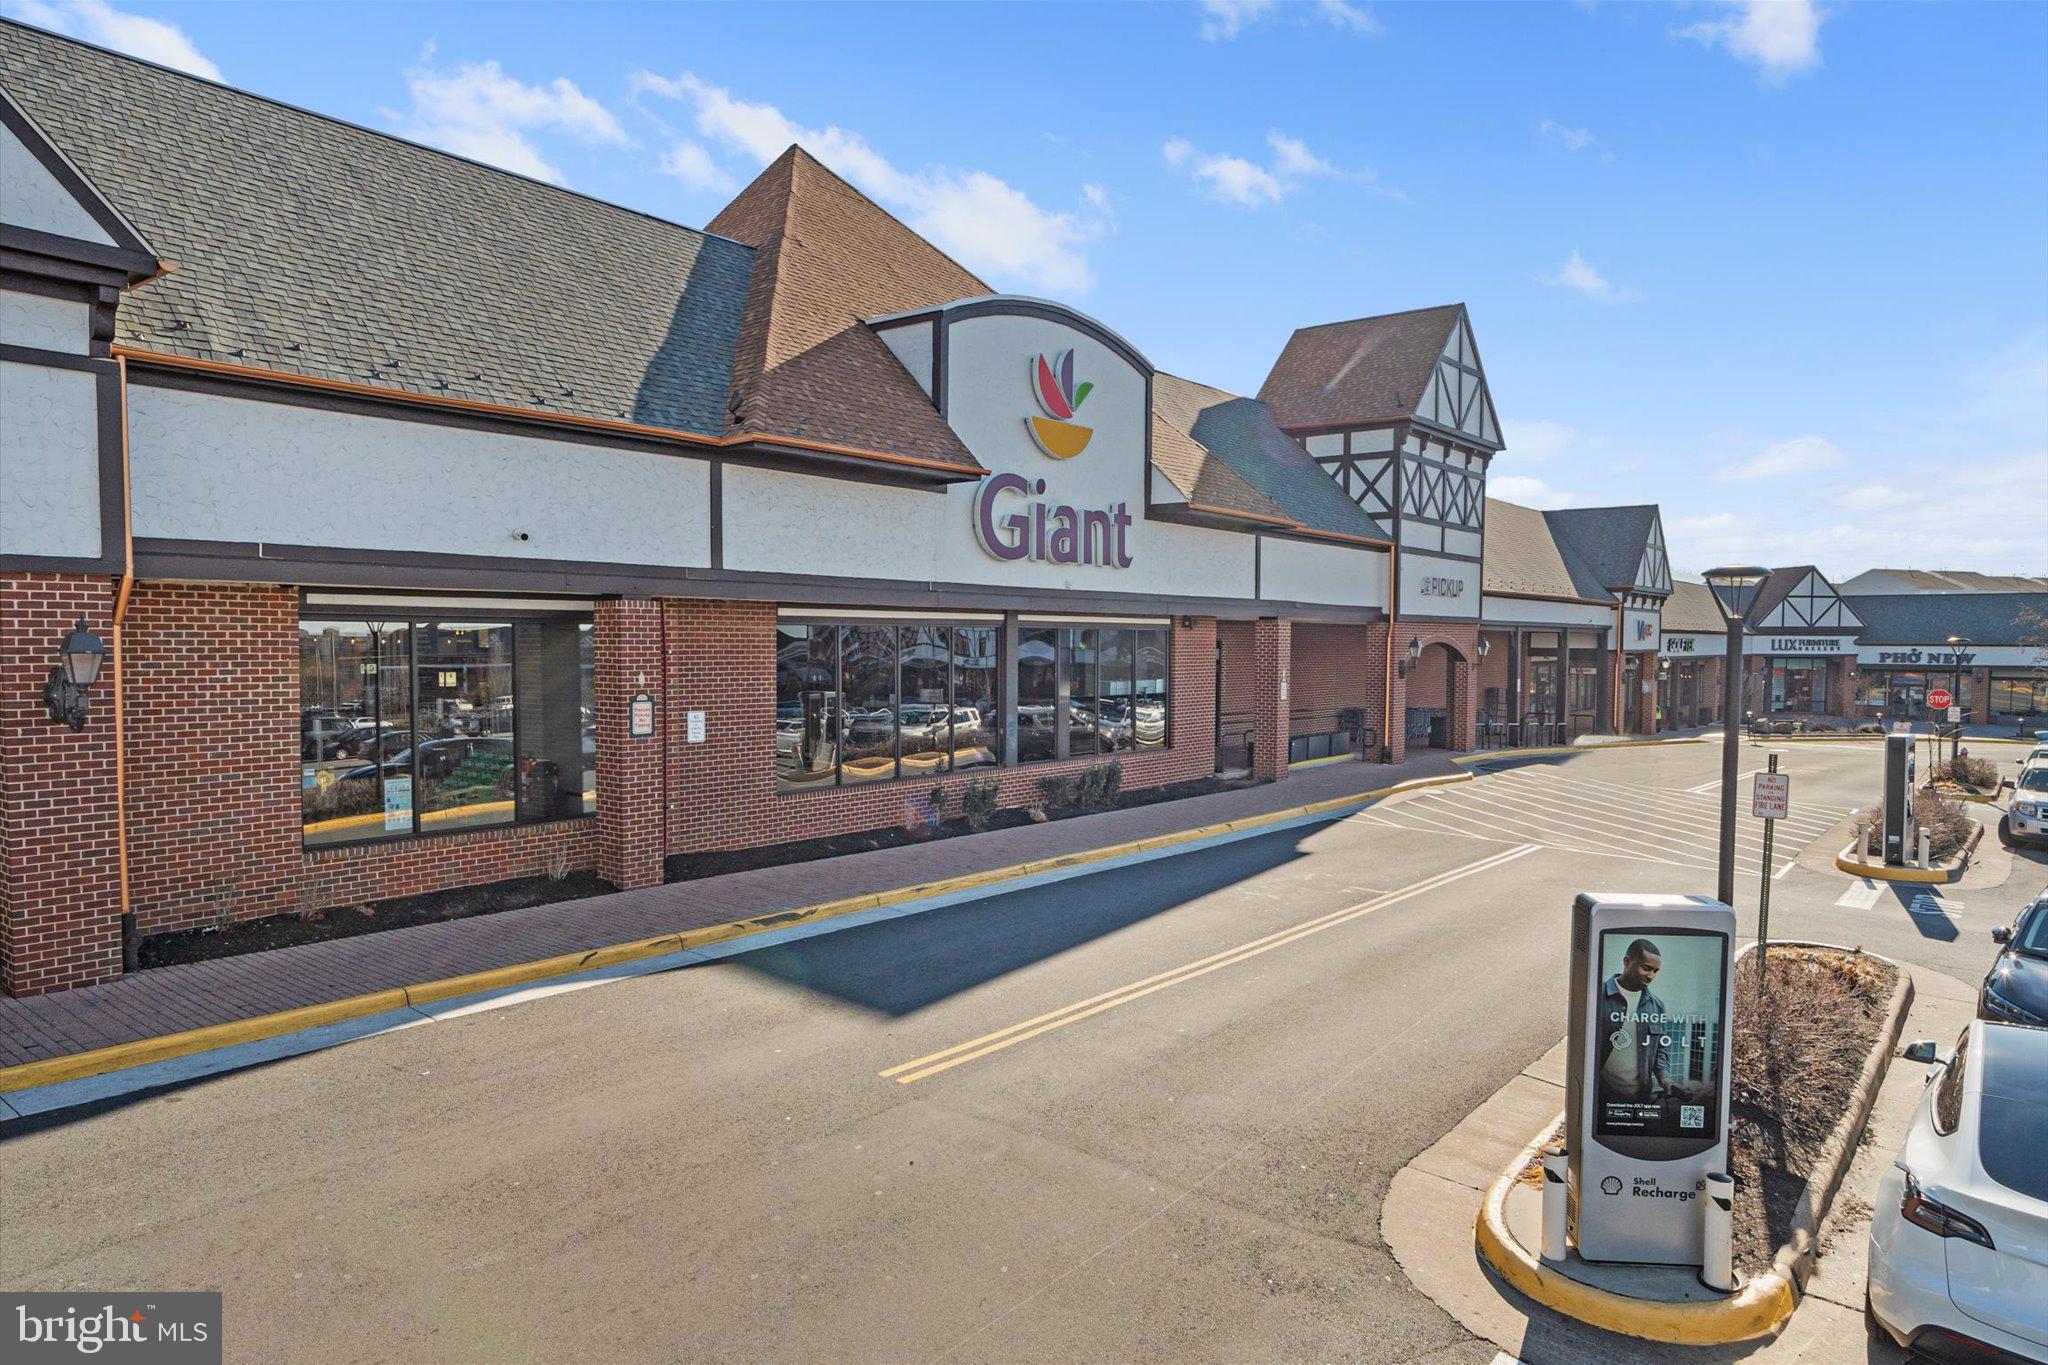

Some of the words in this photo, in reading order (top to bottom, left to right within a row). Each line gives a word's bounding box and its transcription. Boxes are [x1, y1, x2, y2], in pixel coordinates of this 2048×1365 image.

[973, 473, 1133, 569] Giant
[1431, 577, 1464, 598] PICKUP
[1771, 639, 1797, 651] LUX
[1927, 653, 1976, 664] NEW
[1929, 695, 1950, 704] STOP
[1768, 775, 1776, 783] NO
[1758, 784, 1785, 792] PARKING
[1755, 794, 1785, 802] STANDING
[1755, 801, 1768, 809] FIRE
[1769, 803, 1785, 811] LANE
[1610, 1012, 1668, 1023] CHARGE
[1672, 1014, 1708, 1024] WITH
[1641, 1035, 1707, 1047] JOLT
[1633, 1177, 1656, 1186] Shell
[1632, 1187, 1697, 1201] Recharge
